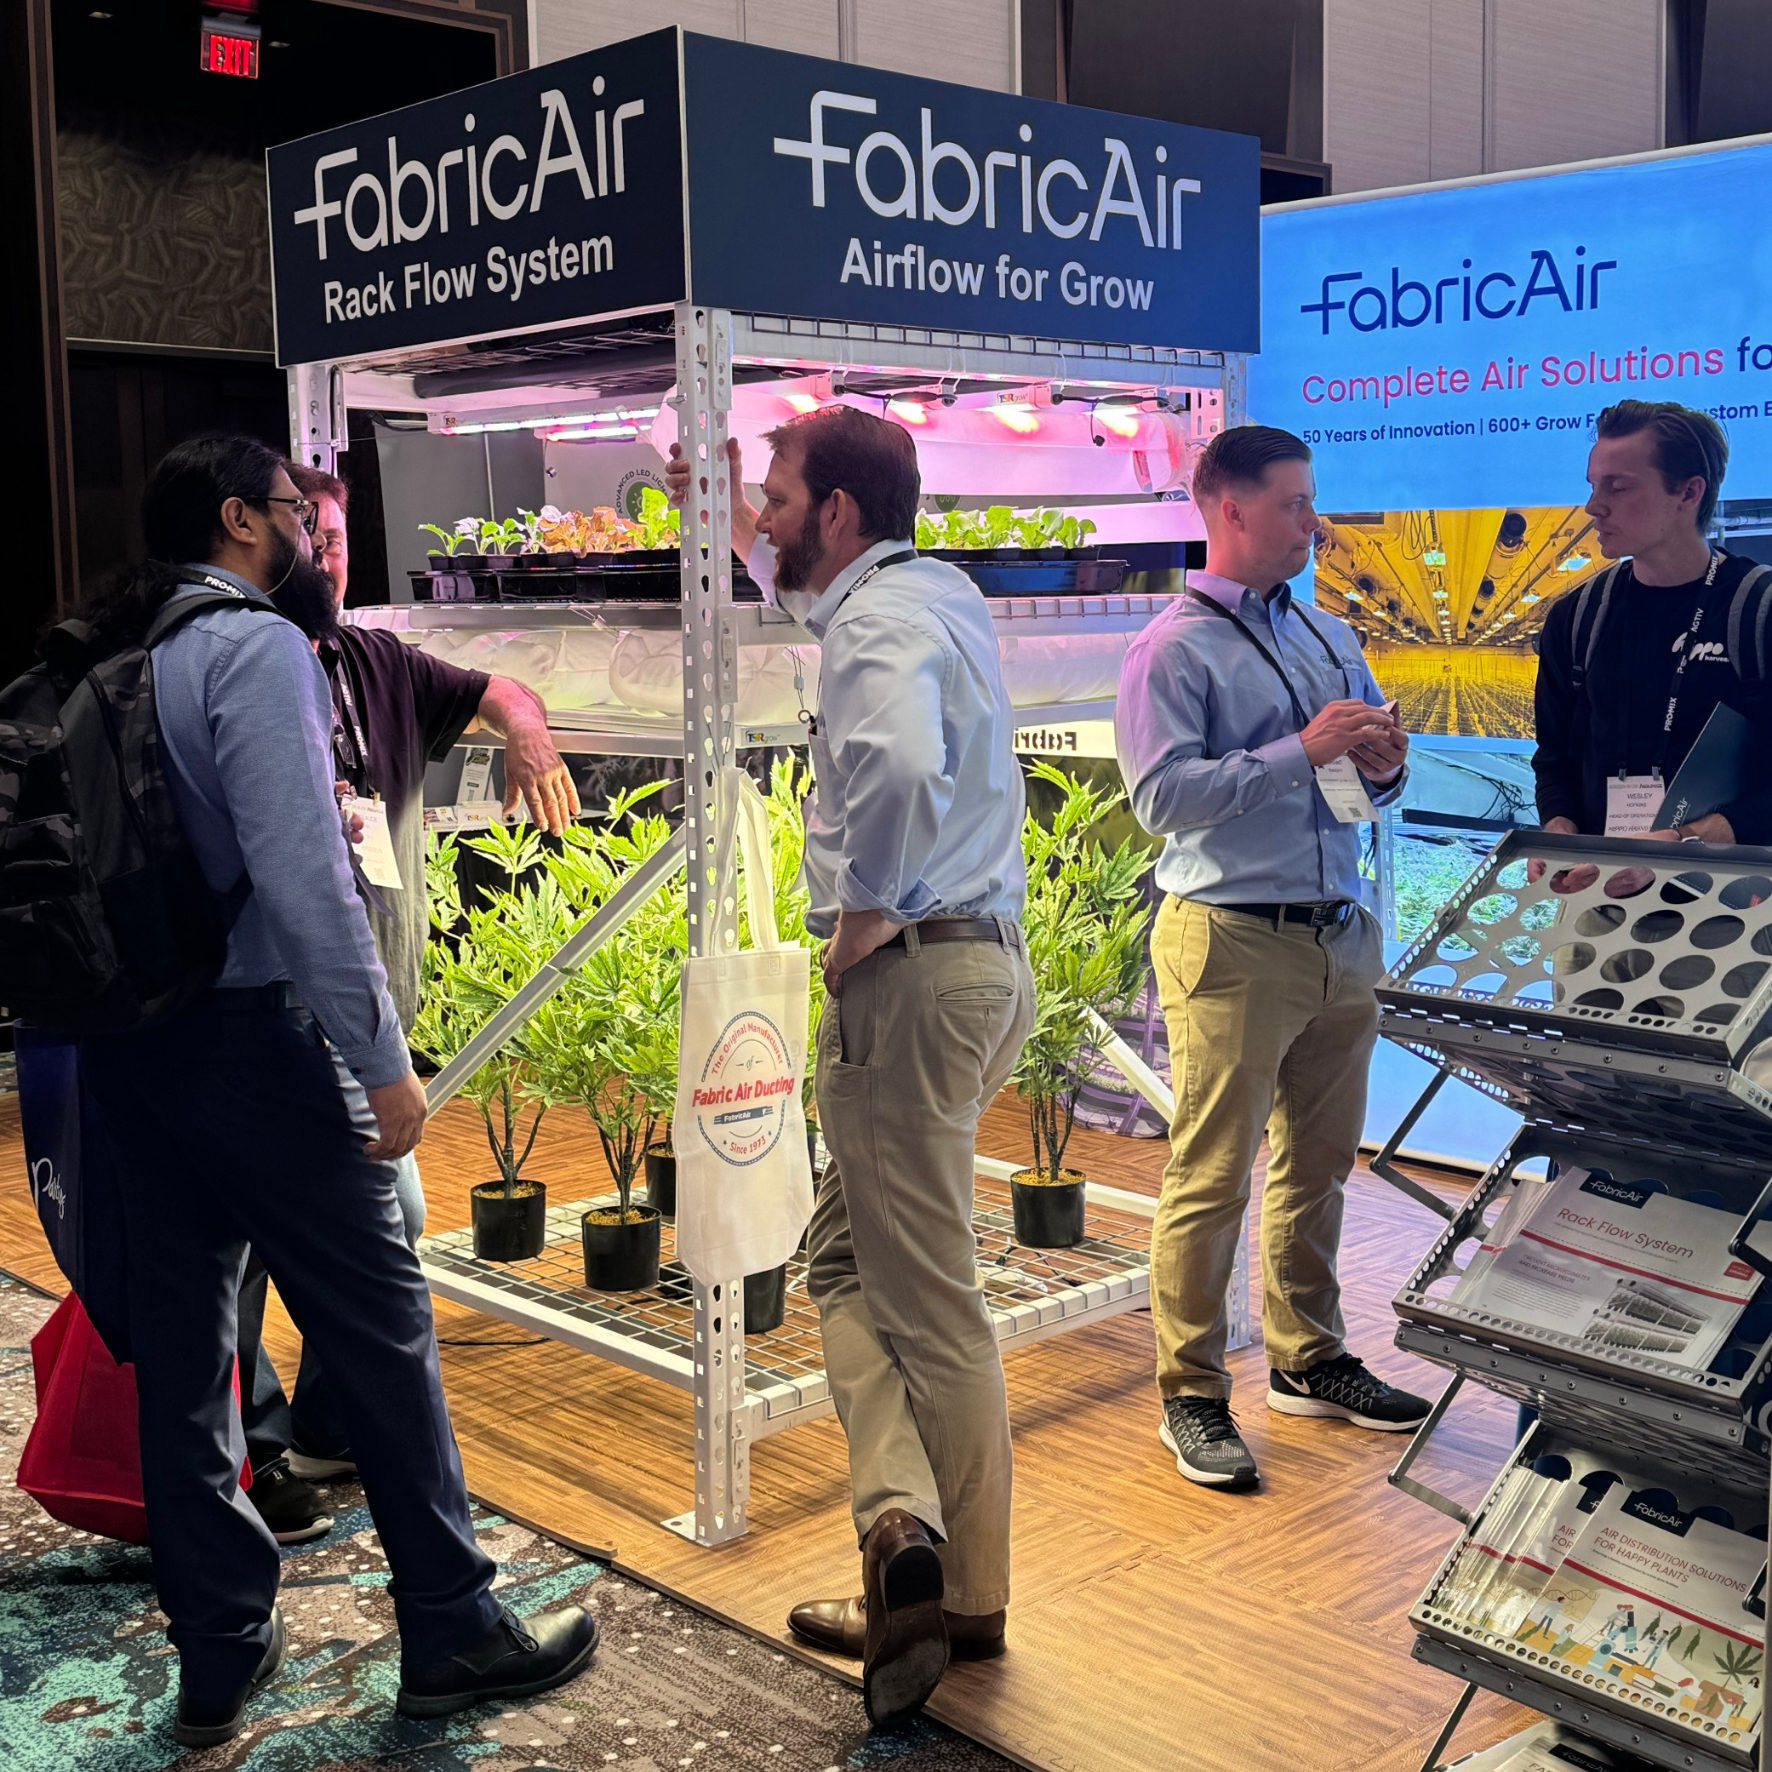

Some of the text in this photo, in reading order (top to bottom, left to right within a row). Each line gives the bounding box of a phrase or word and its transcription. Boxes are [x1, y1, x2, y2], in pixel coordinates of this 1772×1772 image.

[209, 34, 252, 76] EXIT
[294, 76, 644, 260] FabricAir
[773, 90, 1201, 250] FabricAir
[324, 235, 613, 323] Rack Flow System
[840, 237, 1154, 310] Airflow for Grow
[1300, 245, 1617, 335] FabricAir
[1303, 336, 1772, 408] Complete Air Solutions fo
[1303, 430, 1321, 444] 50
[1325, 427, 1367, 442] Years
[1371, 425, 1386, 440] of
[1389, 420, 1475, 438] Innovation
[1488, 417, 1531, 434] 600+
[1535, 415, 1583, 431] Grow
[1689, 404, 1758, 420] stom
[616, 469, 668, 514] ADVANCED LED LIGH
[711, 1022, 783, 1075] The Original Manufacturer
[745, 1055, 754, 1071] of
[692, 1076, 795, 1107] Fabric Air Ducting
[729, 1135, 766, 1154] Since 1973
[1590, 1180, 1644, 1202] FabricAir
[1557, 1208, 1596, 1229] Rack
[1597, 1221, 1634, 1240] Flow
[1635, 1233, 1694, 1259] System
[1558, 1524, 1576, 1538] AIR
[1634, 1501, 1682, 1527] FabricAir
[1552, 1534, 1574, 1549] FOR
[1594, 1536, 1615, 1553] FOR
[1616, 1544, 1651, 1567] HAPPY
[1651, 1562, 1690, 1583] PLANTS
[1601, 1527, 1619, 1541] AIR
[1620, 1535, 1689, 1571] DISTRIBUTION
[1689, 1564, 1748, 1593] SOLUTIONS
